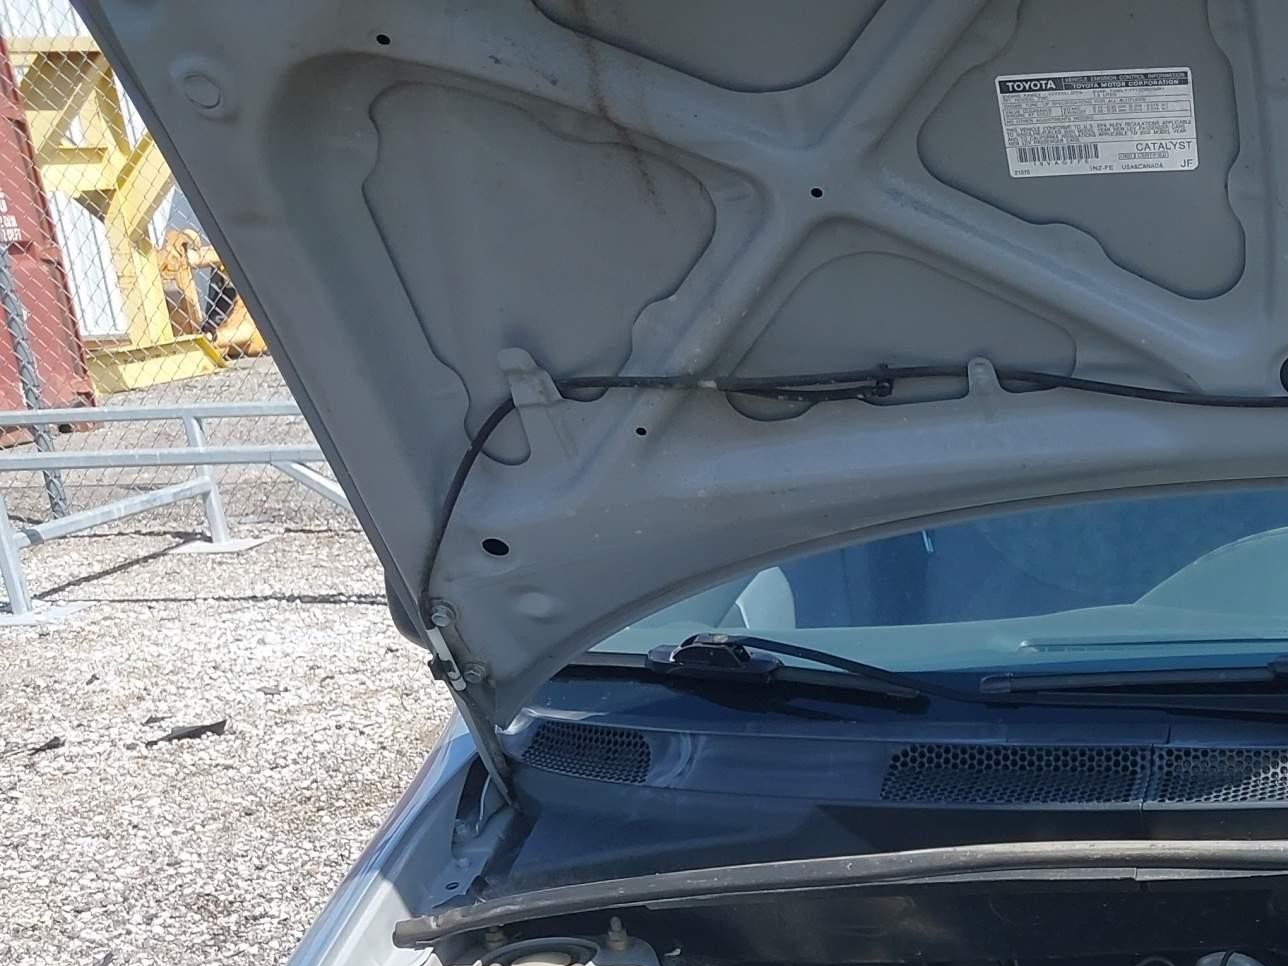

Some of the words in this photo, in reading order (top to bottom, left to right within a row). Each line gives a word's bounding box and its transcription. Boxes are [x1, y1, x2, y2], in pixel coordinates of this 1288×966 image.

[1006, 80, 1056, 91] TOYOTA
[1128, 79, 1179, 87] CORPORATION
[1135, 140, 1192, 152] CATALYST
[1180, 159, 1193, 168] JF
